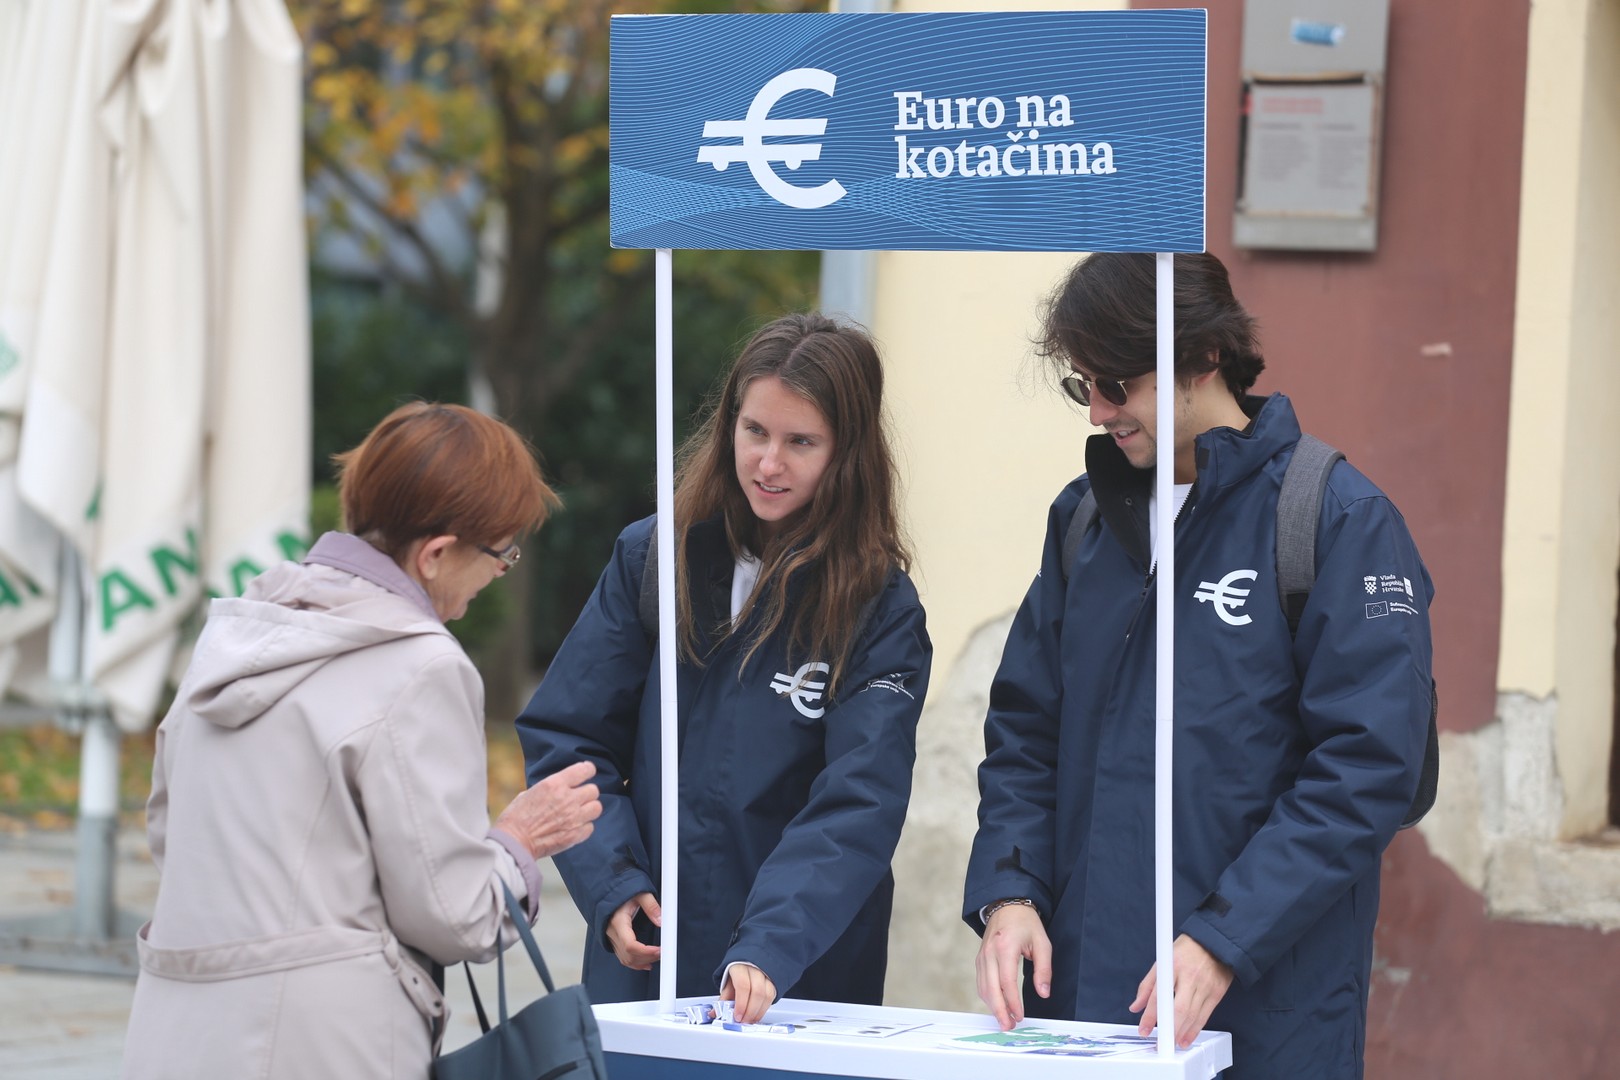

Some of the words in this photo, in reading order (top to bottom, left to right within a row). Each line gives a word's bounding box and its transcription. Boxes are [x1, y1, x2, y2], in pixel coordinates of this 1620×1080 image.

[893, 90, 1005, 131] Euro
[1015, 94, 1075, 128] na
[894, 128, 1118, 179] kotačima
